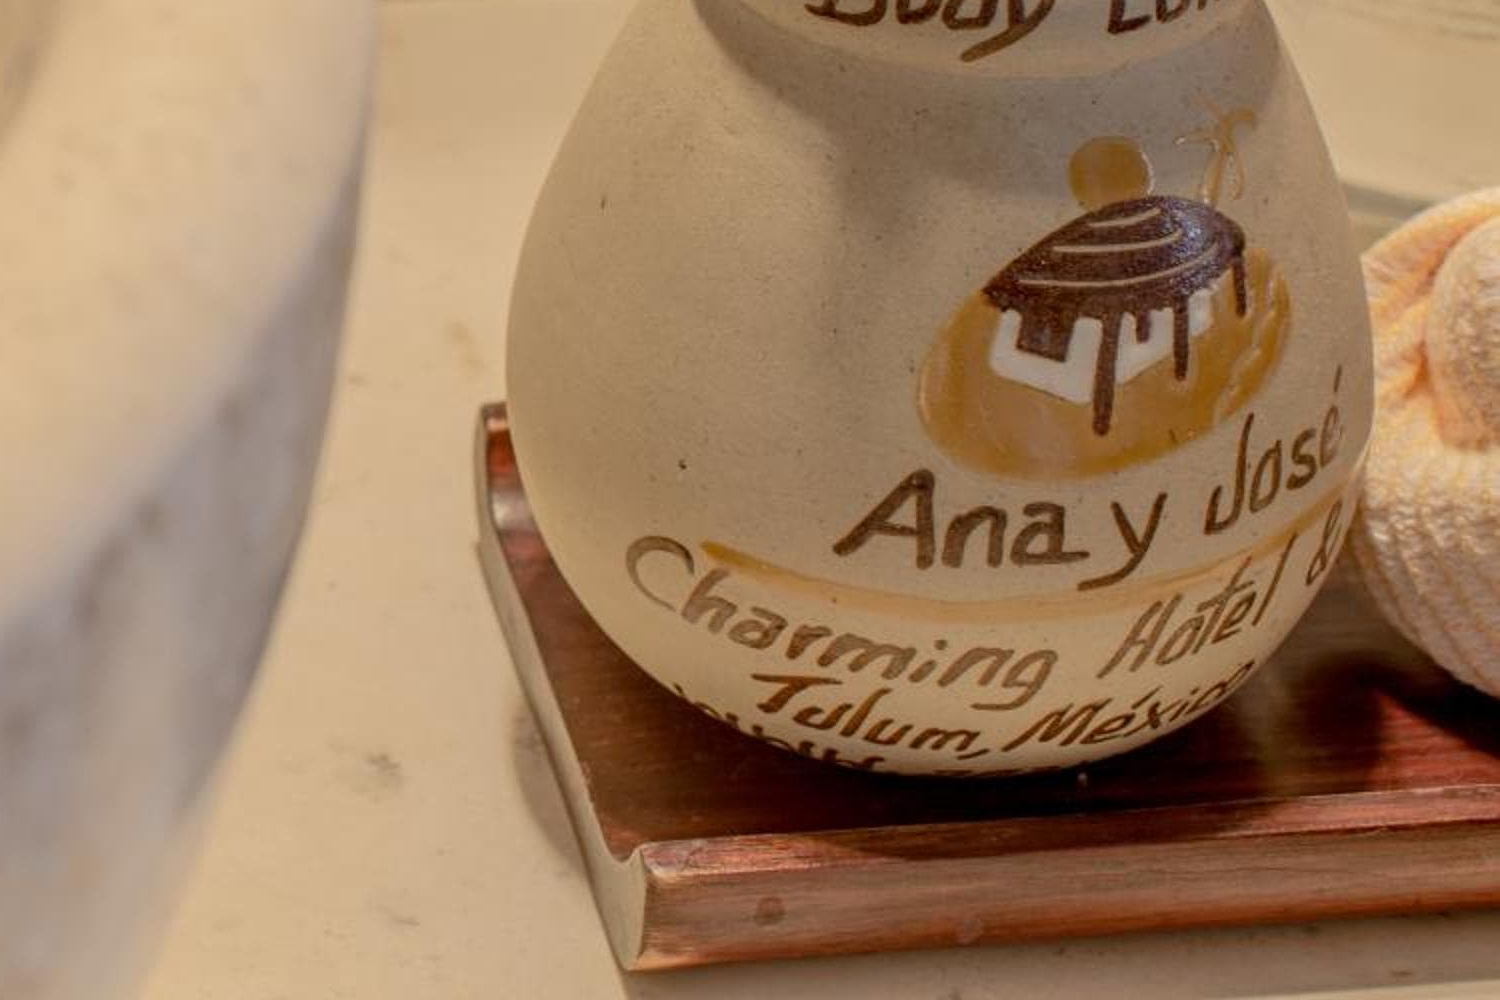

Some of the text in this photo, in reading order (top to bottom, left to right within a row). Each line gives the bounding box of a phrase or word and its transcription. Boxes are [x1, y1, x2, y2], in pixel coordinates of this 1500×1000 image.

[1204, 364, 1345, 536] José
[624, 533, 1060, 711] Charming
[1096, 532, 1298, 679] Hotel
[751, 672, 990, 761] Tulum,
[1002, 659, 1256, 754] México
